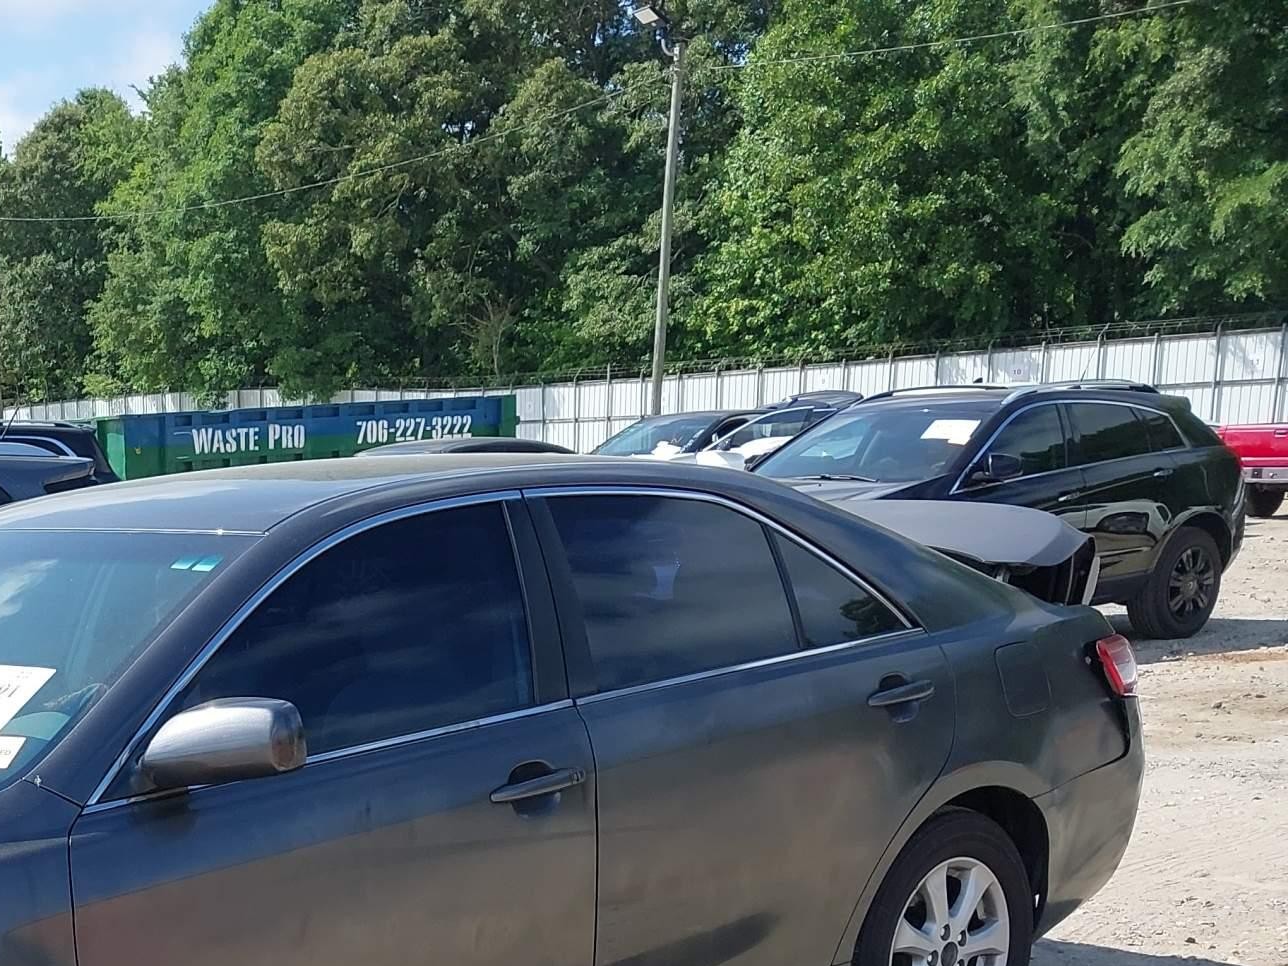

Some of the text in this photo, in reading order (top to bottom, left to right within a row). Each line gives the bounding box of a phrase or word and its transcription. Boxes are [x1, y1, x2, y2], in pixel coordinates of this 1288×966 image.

[192, 423, 305, 454] WASTE PRO
[356, 415, 472, 445] 706-227-3222
